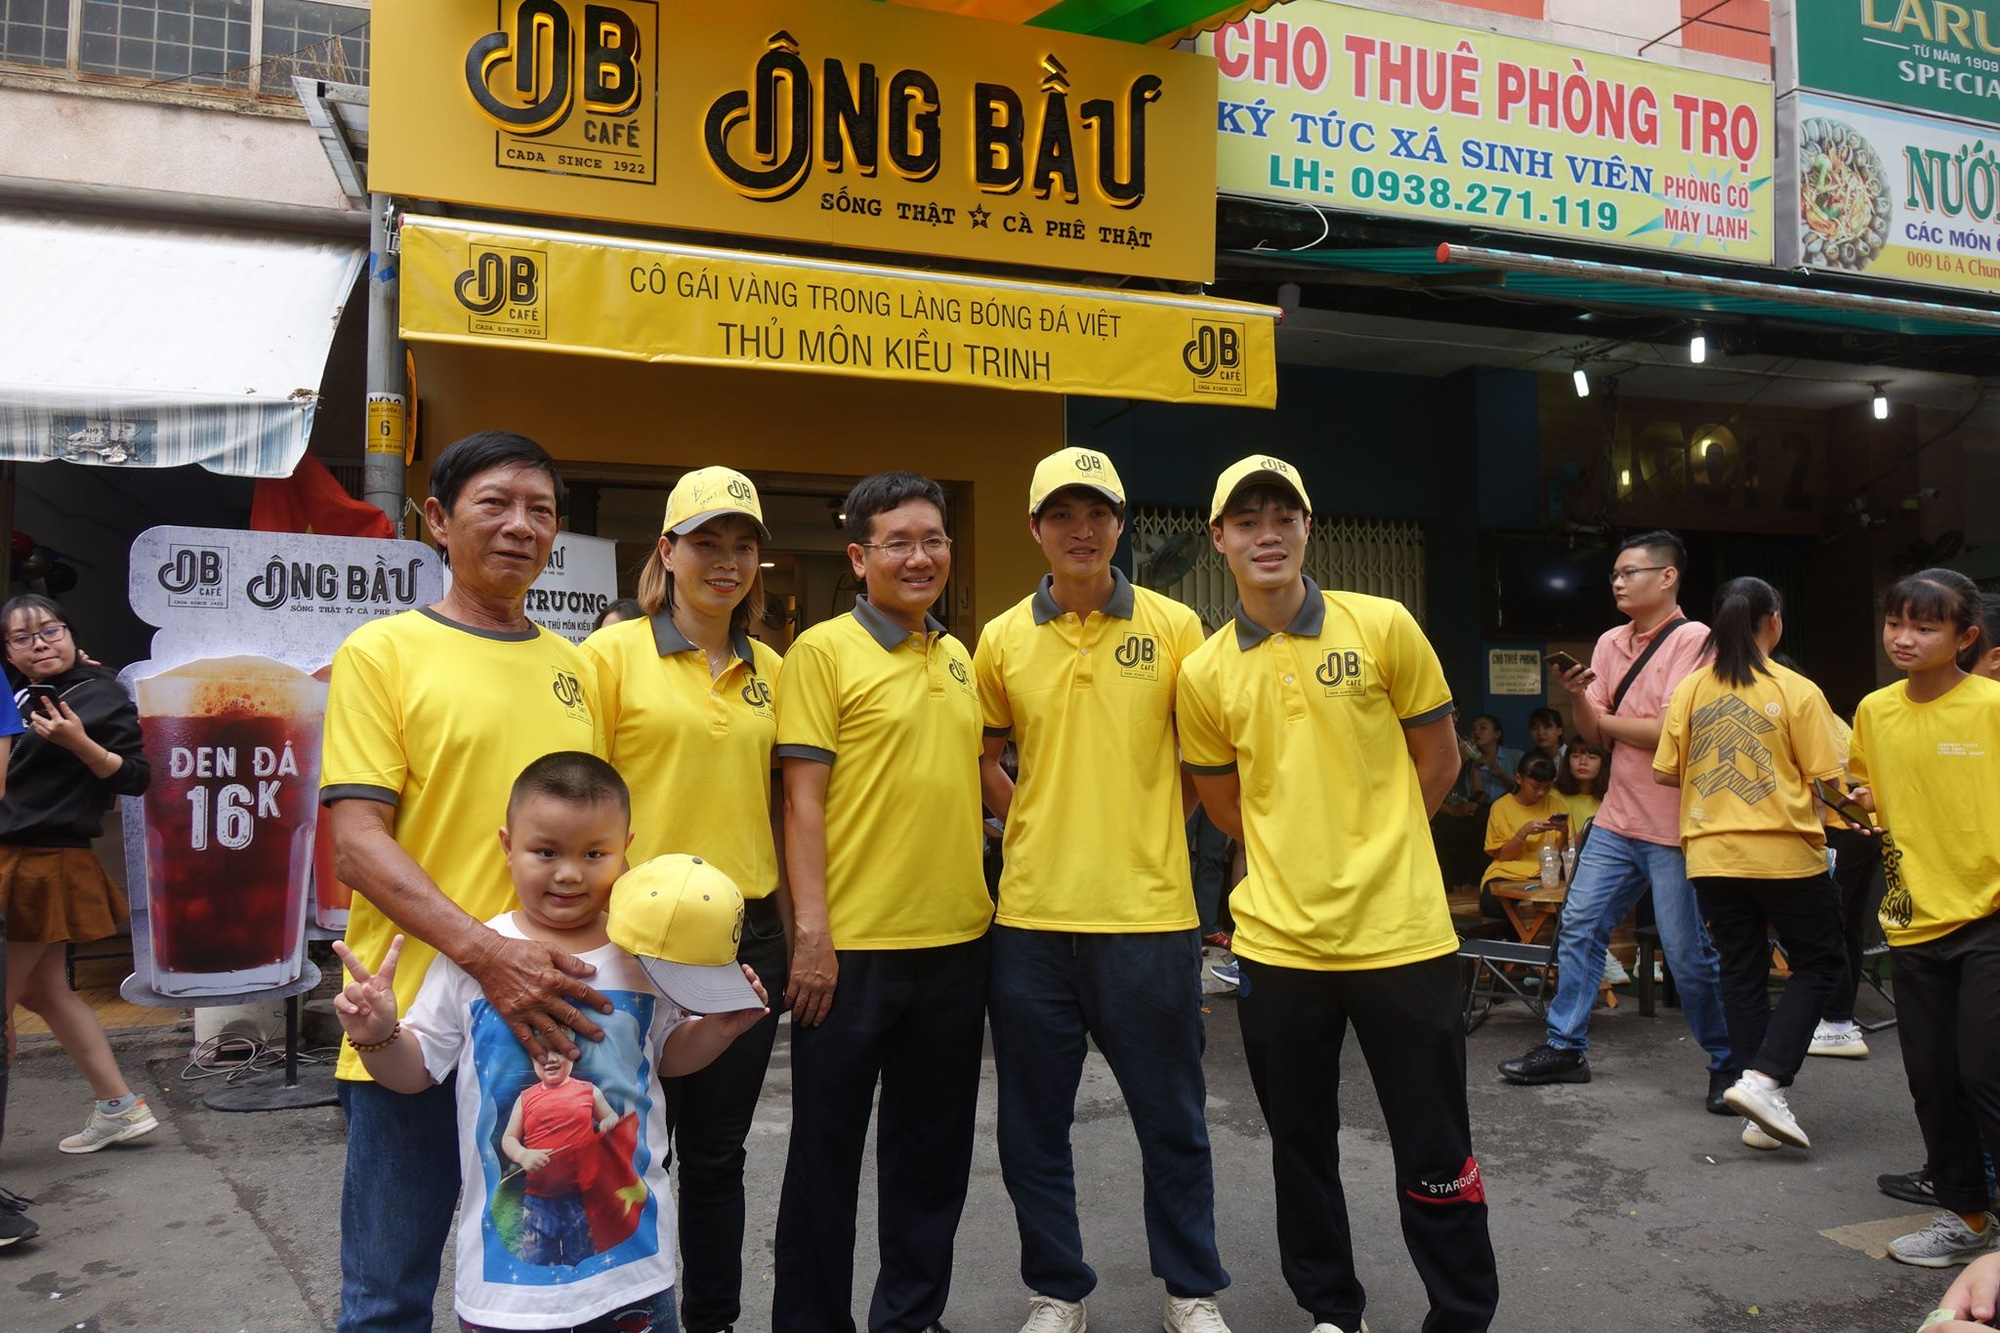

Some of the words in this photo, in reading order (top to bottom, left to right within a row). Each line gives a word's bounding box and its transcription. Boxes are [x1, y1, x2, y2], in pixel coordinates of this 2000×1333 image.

[1912, 43, 1930, 58] TỪ
[1933, 48, 1961, 65] NĂM
[1965, 56, 1999, 73] 1909
[1212, 17, 1329, 92] CHO
[1344, 34, 1482, 118] THUÊ
[1497, 57, 1660, 148] PHÒNG
[1673, 93, 1760, 174] TRỌ
[703, 29, 940, 201] ÔNG
[584, 120, 640, 148] CAFÉ
[1218, 98, 1276, 138] KÝ
[1291, 109, 1376, 153] TÚC
[1390, 127, 1448, 164] XÁ
[1462, 139, 1553, 179] SINH
[1566, 154, 1654, 194] VIÊN
[506, 148, 546, 163] CADA
[557, 155, 603, 169] SINCE
[613, 160, 646, 175] 1922
[1269, 154, 1334, 194] LH:
[1352, 167, 1618, 231] 0938.271.119
[1663, 174, 1722, 209] PHÒNG
[1726, 178, 1750, 210] CÓ
[820, 185, 882, 218] SỐNG
[897, 202, 956, 226] THẬT
[1003, 211, 1033, 234] CÀ
[1046, 218, 1086, 242] PHÊ
[1099, 226, 1152, 248] THẬT
[1663, 206, 1702, 235] MÁY
[1706, 221, 1749, 241] LẠNH
[1905, 221, 1944, 244] CÁC
[1949, 228, 1991, 252] MÓN
[1907, 250, 1932, 269] 009
[1936, 255, 1951, 272] Lô
[1955, 257, 1965, 274] A
[509, 308, 539, 322] CAFÉ
[630, 263, 666, 295] CÔ
[677, 267, 720, 300] GÁI
[728, 270, 798, 309] VÀNG
[807, 283, 890, 317] TRONG
[900, 288, 960, 320] LÀNG
[970, 296, 1032, 331] BÓNG
[1039, 304, 1070, 335] ĐÁ
[1079, 311, 1122, 342] VIỆT
[497, 326, 520, 334] SINCE
[524, 328, 541, 336] 1922
[718, 316, 784, 360] THỦ
[799, 325, 872, 367] MÔN
[885, 328, 952, 374] KIỀU
[964, 343, 1050, 382] TRINH
[1220, 370, 1240, 381] CAFÉ
[380, 420, 391, 437] 6
[200, 587, 222, 597] CAFÉ
[246, 554, 338, 610] ÔNG
[169, 746, 236, 778] ĐEN
